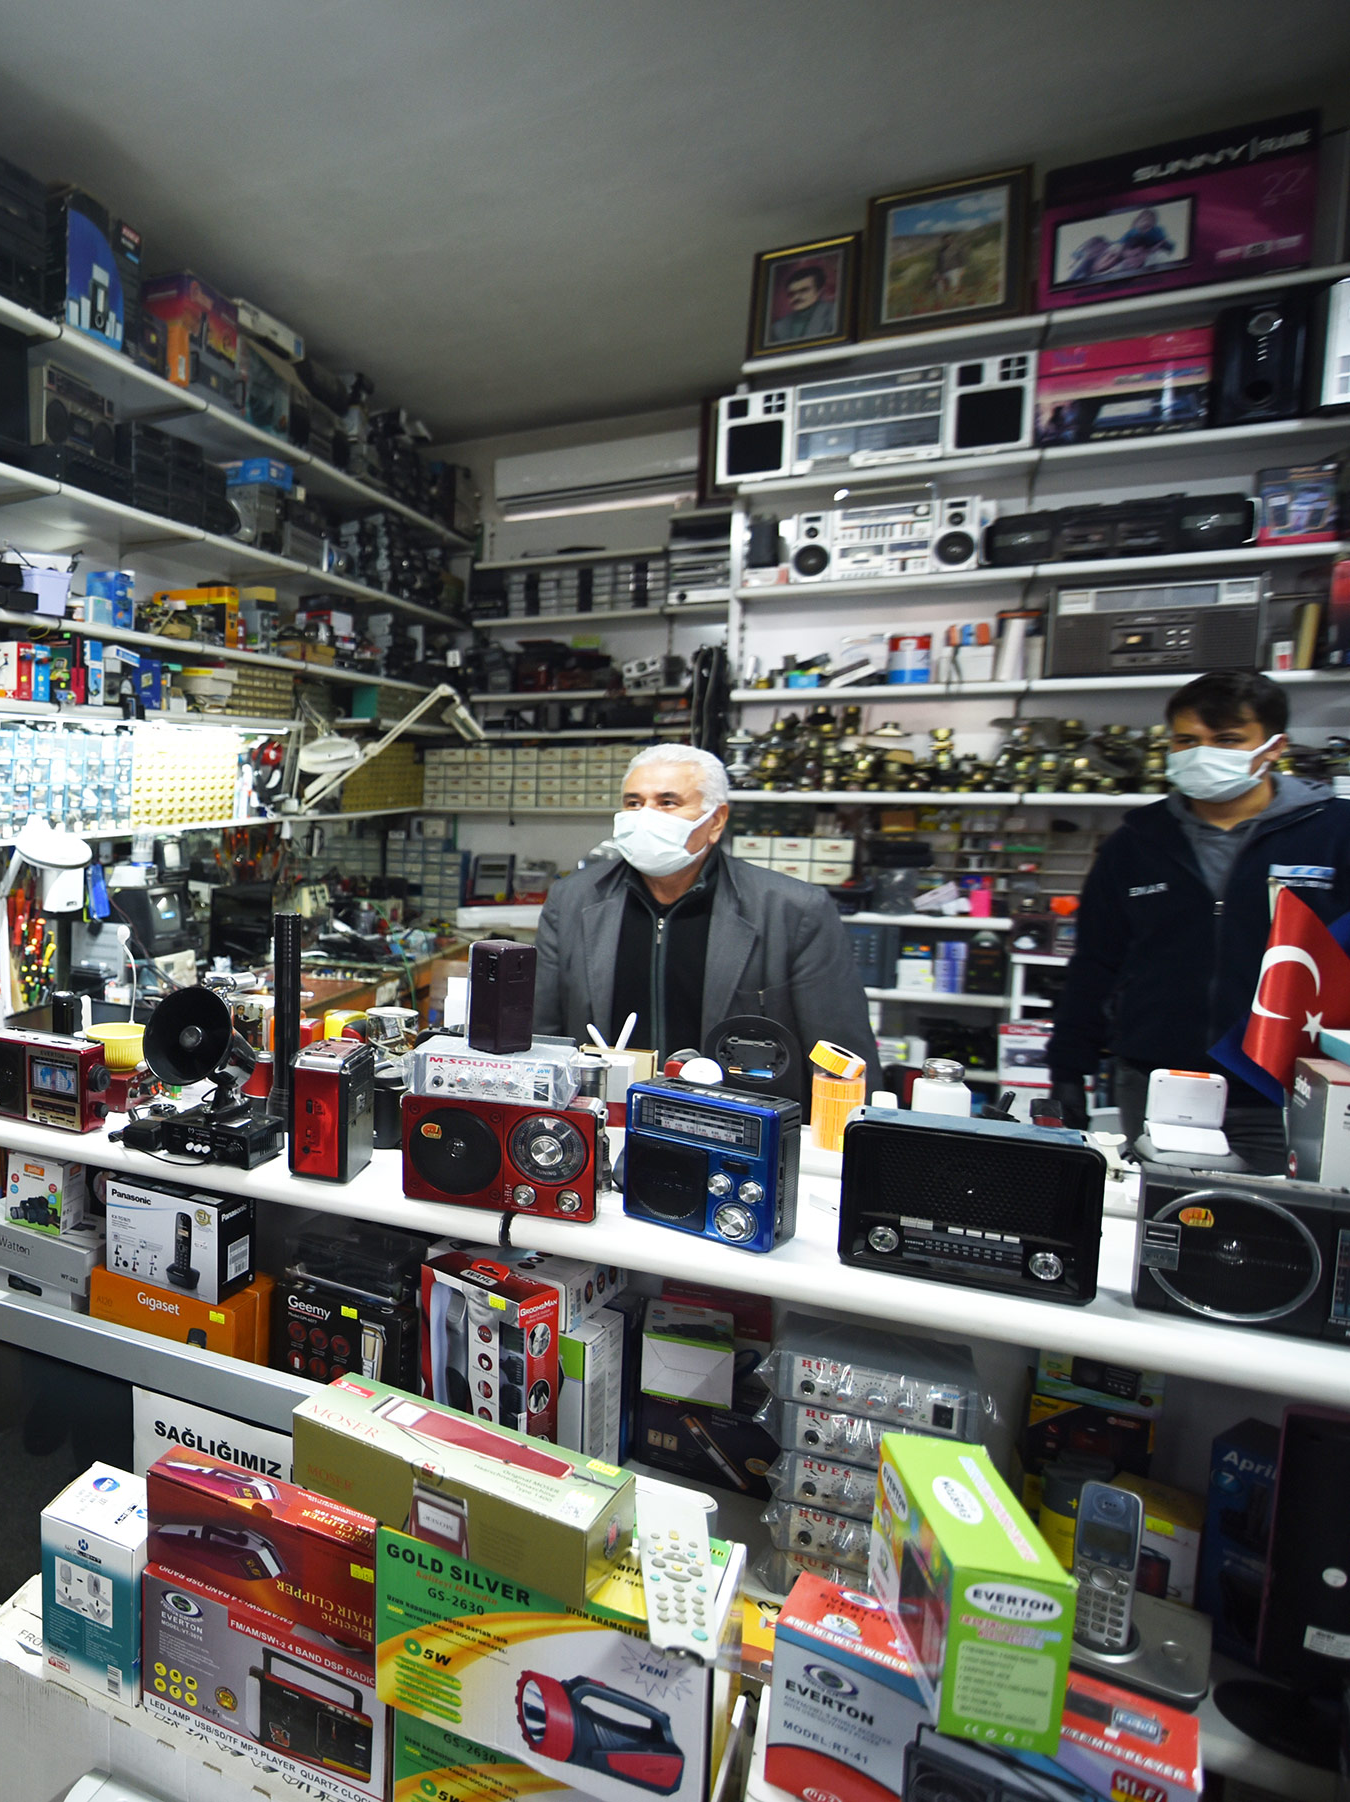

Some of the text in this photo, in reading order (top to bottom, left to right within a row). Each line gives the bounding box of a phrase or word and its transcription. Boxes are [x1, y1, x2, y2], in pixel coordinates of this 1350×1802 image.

[1132, 143, 1249, 184] SUNNY
[429, 1056, 512, 1070] M-SOUND
[111, 1188, 152, 1206] Panasonic
[221, 1203, 248, 1222] Panasonic
[465, 1270, 493, 1285] WAHL
[137, 1291, 181, 1317] Gigaset
[288, 1294, 331, 1321] Geemy
[307, 1404, 380, 1439] MOSER
[154, 1420, 282, 1480] SAĞLIĞIMIZ
[803, 1459, 852, 1479] HUES
[301, 1509, 353, 1532] CLIPPER
[798, 1508, 848, 1530] HUES
[386, 1542, 531, 1608] GOLD SILVER
[276, 1579, 373, 1629] HAIR CLIPPER
[427, 1586, 486, 1617] GS-2630
[972, 1587, 1055, 1614] EVERTON
[161, 1610, 203, 1634] EVERTON
[321, 1612, 373, 1643] Electric
[565, 1605, 589, 1621] UZUN
[590, 1612, 633, 1637] ARAMALI
[18, 1628, 43, 1650] FRO
[295, 1645, 322, 1665] BAND
[324, 1657, 344, 1673] DSP
[422, 1648, 453, 1668] 5W
[637, 1661, 668, 1680] YENİ
[784, 1678, 876, 1727] EVERTON
[149, 1697, 167, 1712] LED
[167, 1705, 191, 1723] LAMP
[194, 1719, 240, 1747] USB/SD/TF
[240, 1740, 260, 1757] MP3
[260, 1750, 297, 1774] PLAYER
[300, 1768, 340, 1794] QUARTZ
[443, 1733, 498, 1766] GS-2630
